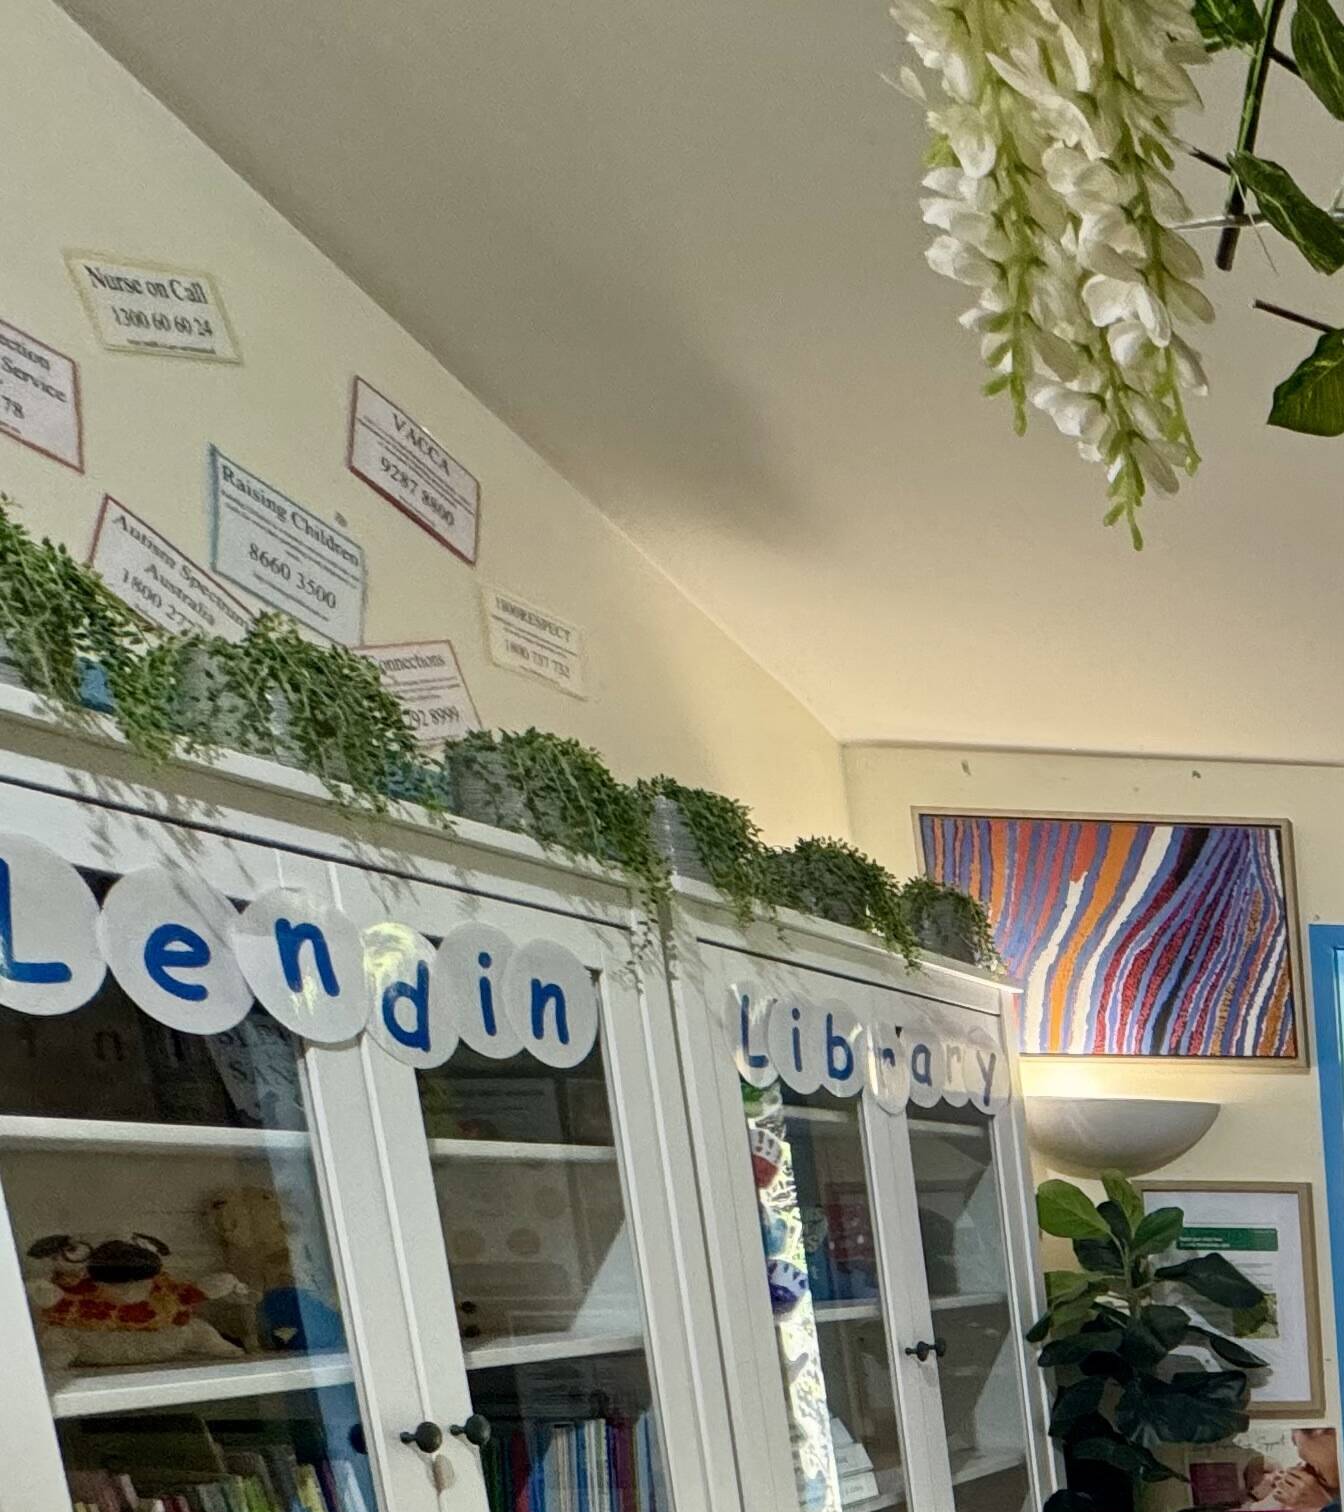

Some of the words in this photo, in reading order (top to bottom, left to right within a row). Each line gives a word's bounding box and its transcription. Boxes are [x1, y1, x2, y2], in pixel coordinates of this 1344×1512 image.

[83, 264, 143, 295] Nurse
[145, 280, 170, 298] on
[168, 279, 208, 304] Call
[393, 413, 451, 478] VACCA
[222, 464, 287, 522] Raising
[291, 511, 360, 567] Children
[249, 542, 291, 581] 8660
[296, 572, 337, 609] 3500
